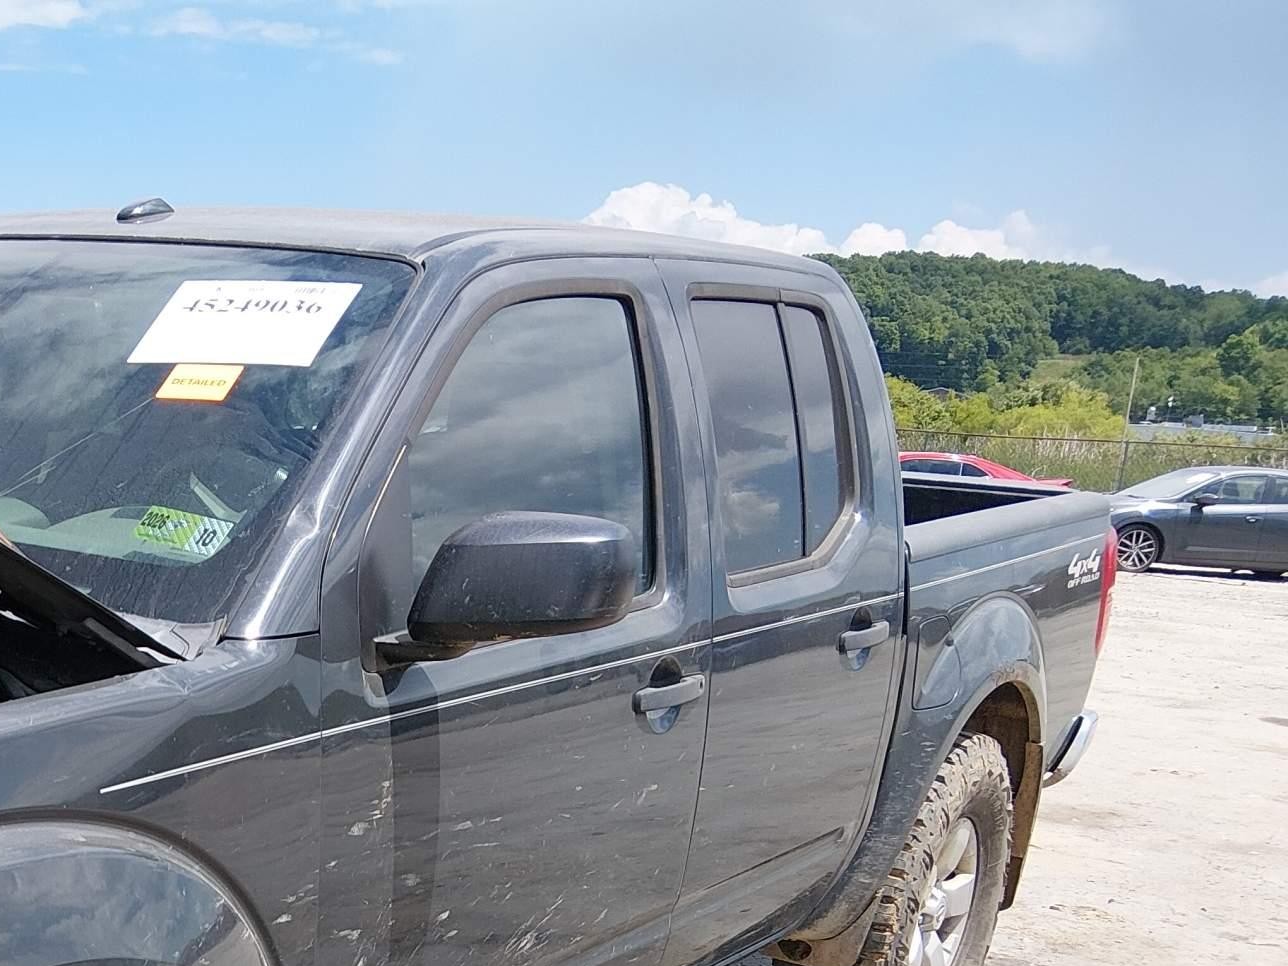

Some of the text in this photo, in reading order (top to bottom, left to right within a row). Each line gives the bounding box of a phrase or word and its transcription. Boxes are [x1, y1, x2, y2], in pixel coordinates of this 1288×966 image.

[183, 298, 323, 314] 45249036
[171, 376, 227, 387] DETAILED
[140, 511, 170, 530] 2026
[196, 528, 217, 546] 10
[1068, 548, 1101, 577] 4x4
